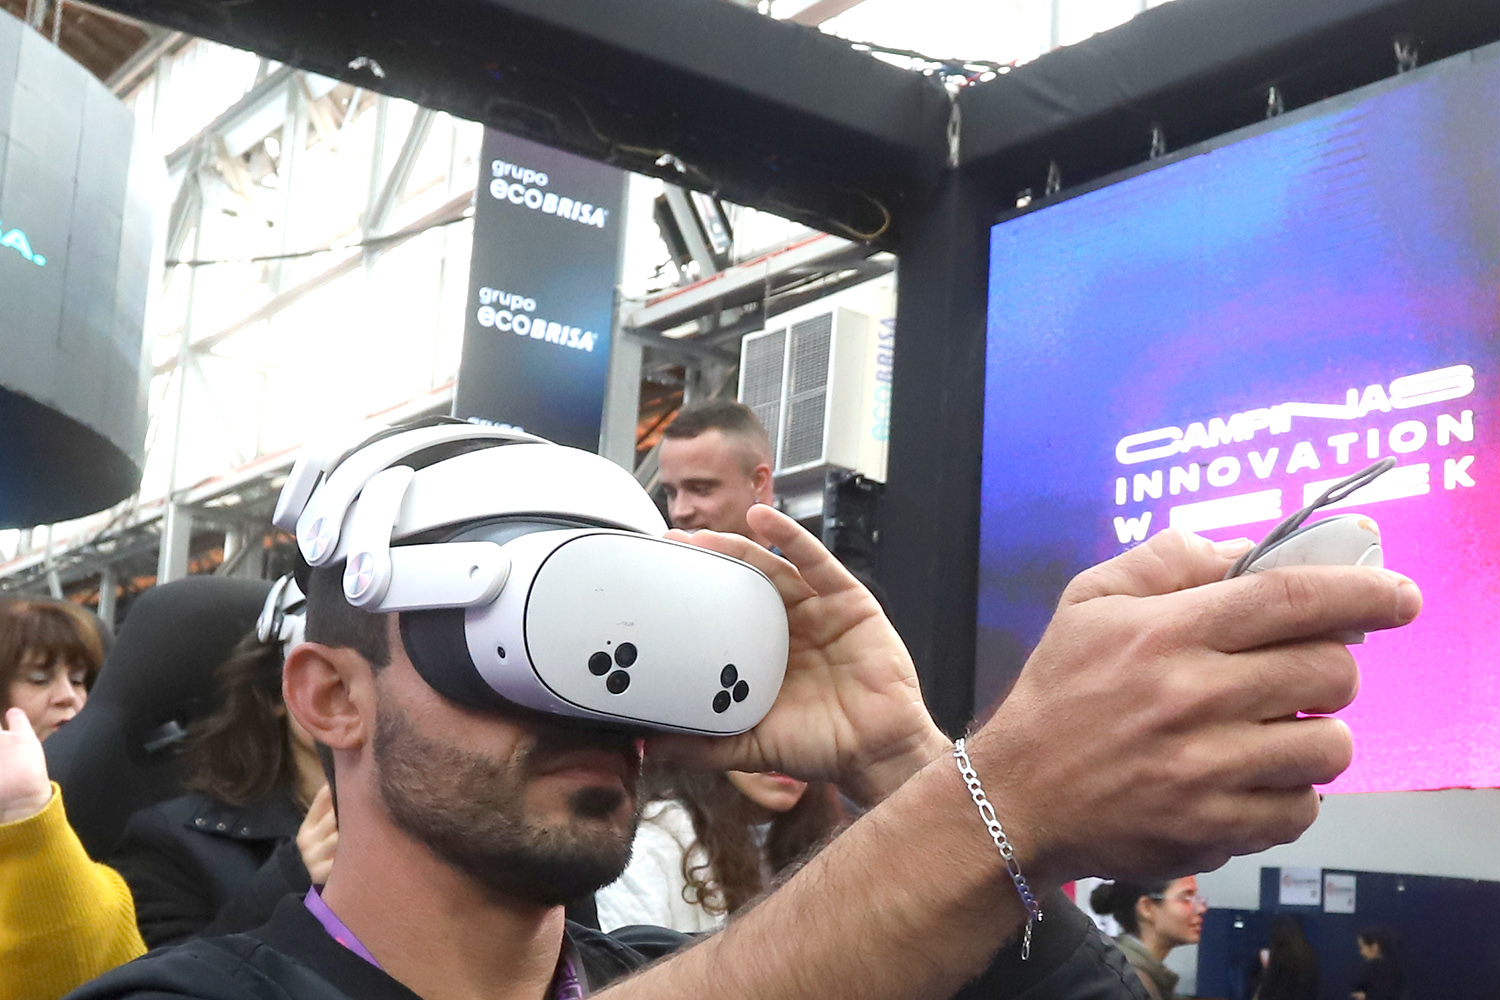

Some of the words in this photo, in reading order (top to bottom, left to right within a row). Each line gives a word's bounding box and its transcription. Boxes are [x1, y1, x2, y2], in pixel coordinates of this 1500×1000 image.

[491, 159, 549, 187] grupo
[478, 286, 537, 312] grupo
[1115, 363, 1475, 465] CAMPINAS
[1114, 409, 1475, 506] INNOVATION
